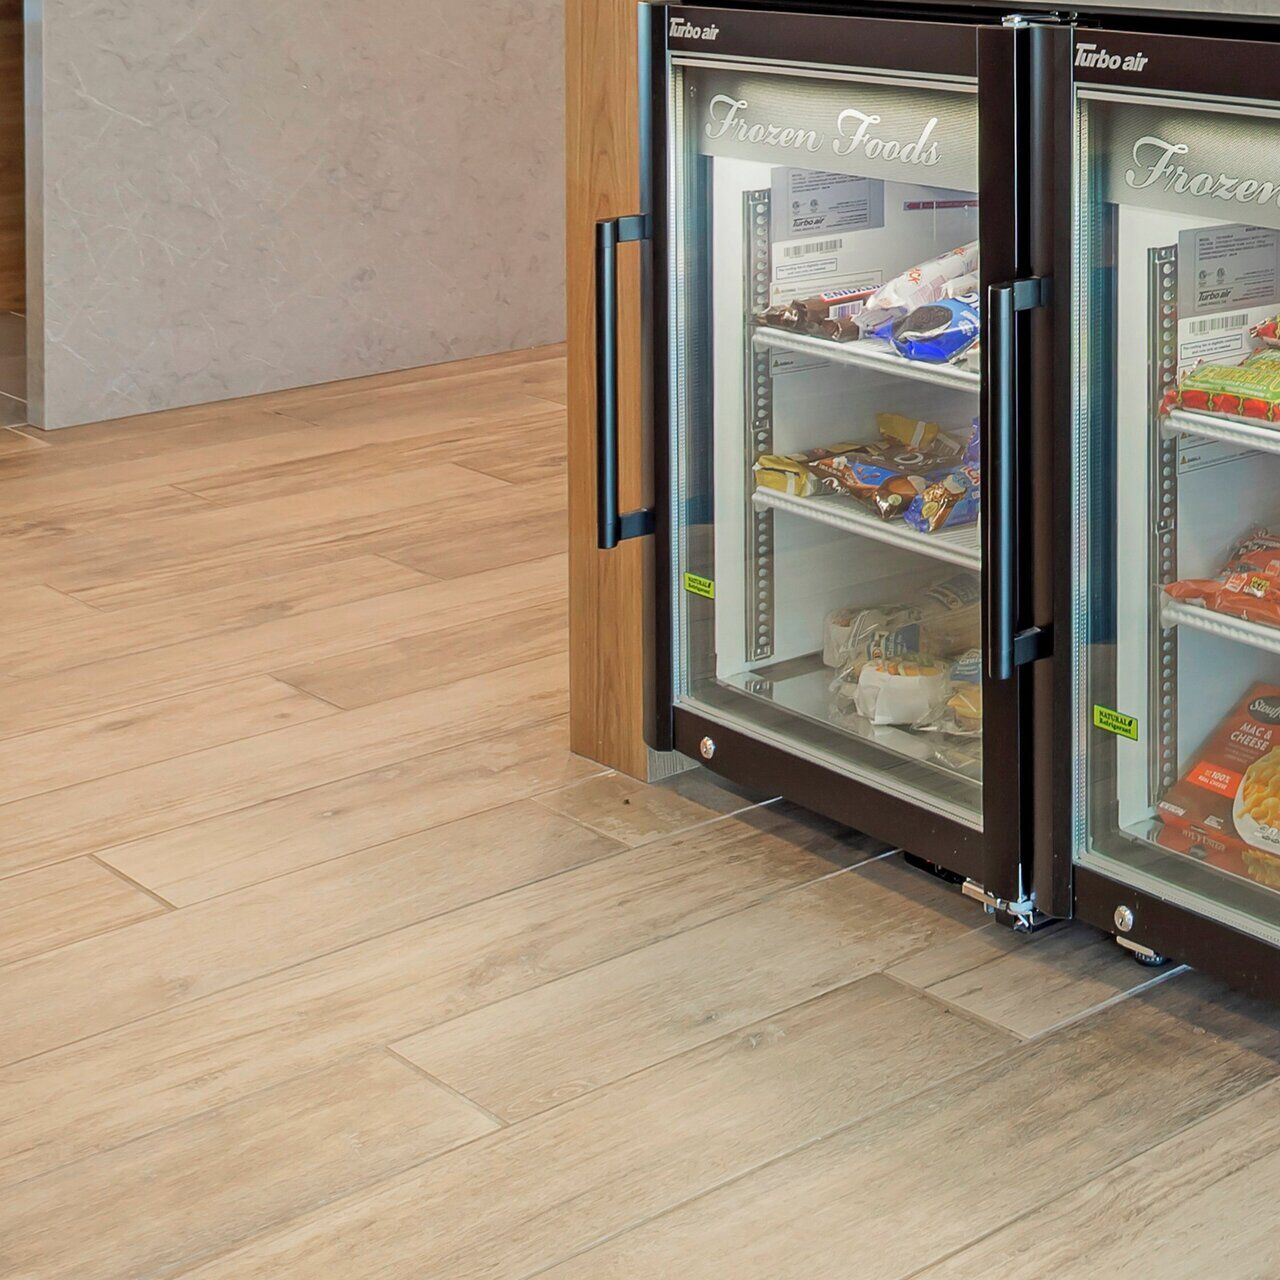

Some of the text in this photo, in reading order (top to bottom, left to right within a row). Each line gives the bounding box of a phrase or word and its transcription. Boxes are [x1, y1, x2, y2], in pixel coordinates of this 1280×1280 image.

[669, 18, 719, 41] Turbo air
[1074, 42, 1148, 73] Turbo air
[705, 94, 941, 166] Frozen Foods
[1099, 709, 1128, 726] NATURAL
[1239, 722, 1273, 739] MAC &
[1230, 731, 1270, 751] CHEESE
[1211, 770, 1232, 784] 100%
